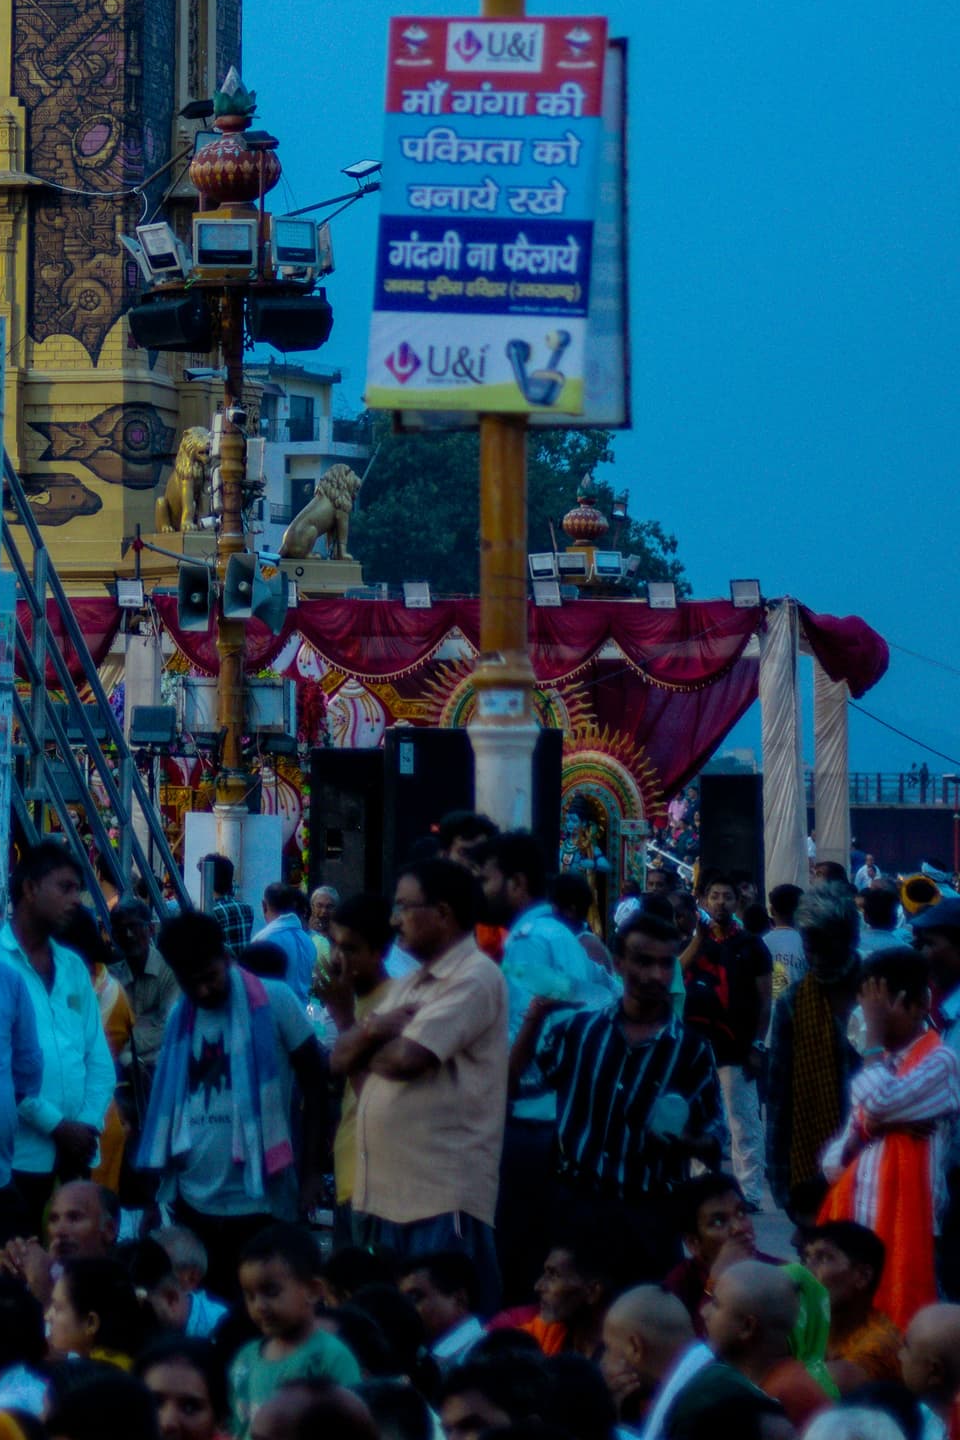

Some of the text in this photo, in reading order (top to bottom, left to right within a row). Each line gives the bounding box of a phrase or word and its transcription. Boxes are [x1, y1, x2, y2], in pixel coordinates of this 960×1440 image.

[487, 31, 537, 62] U&i
[401, 79, 587, 117] माँ गंगा की
[401, 127, 581, 166] पवित्रता को
[408, 177, 568, 215] बनाये रखे
[388, 230, 581, 275] गंदगी ना फैलाये
[426, 343, 490, 385] U&i
